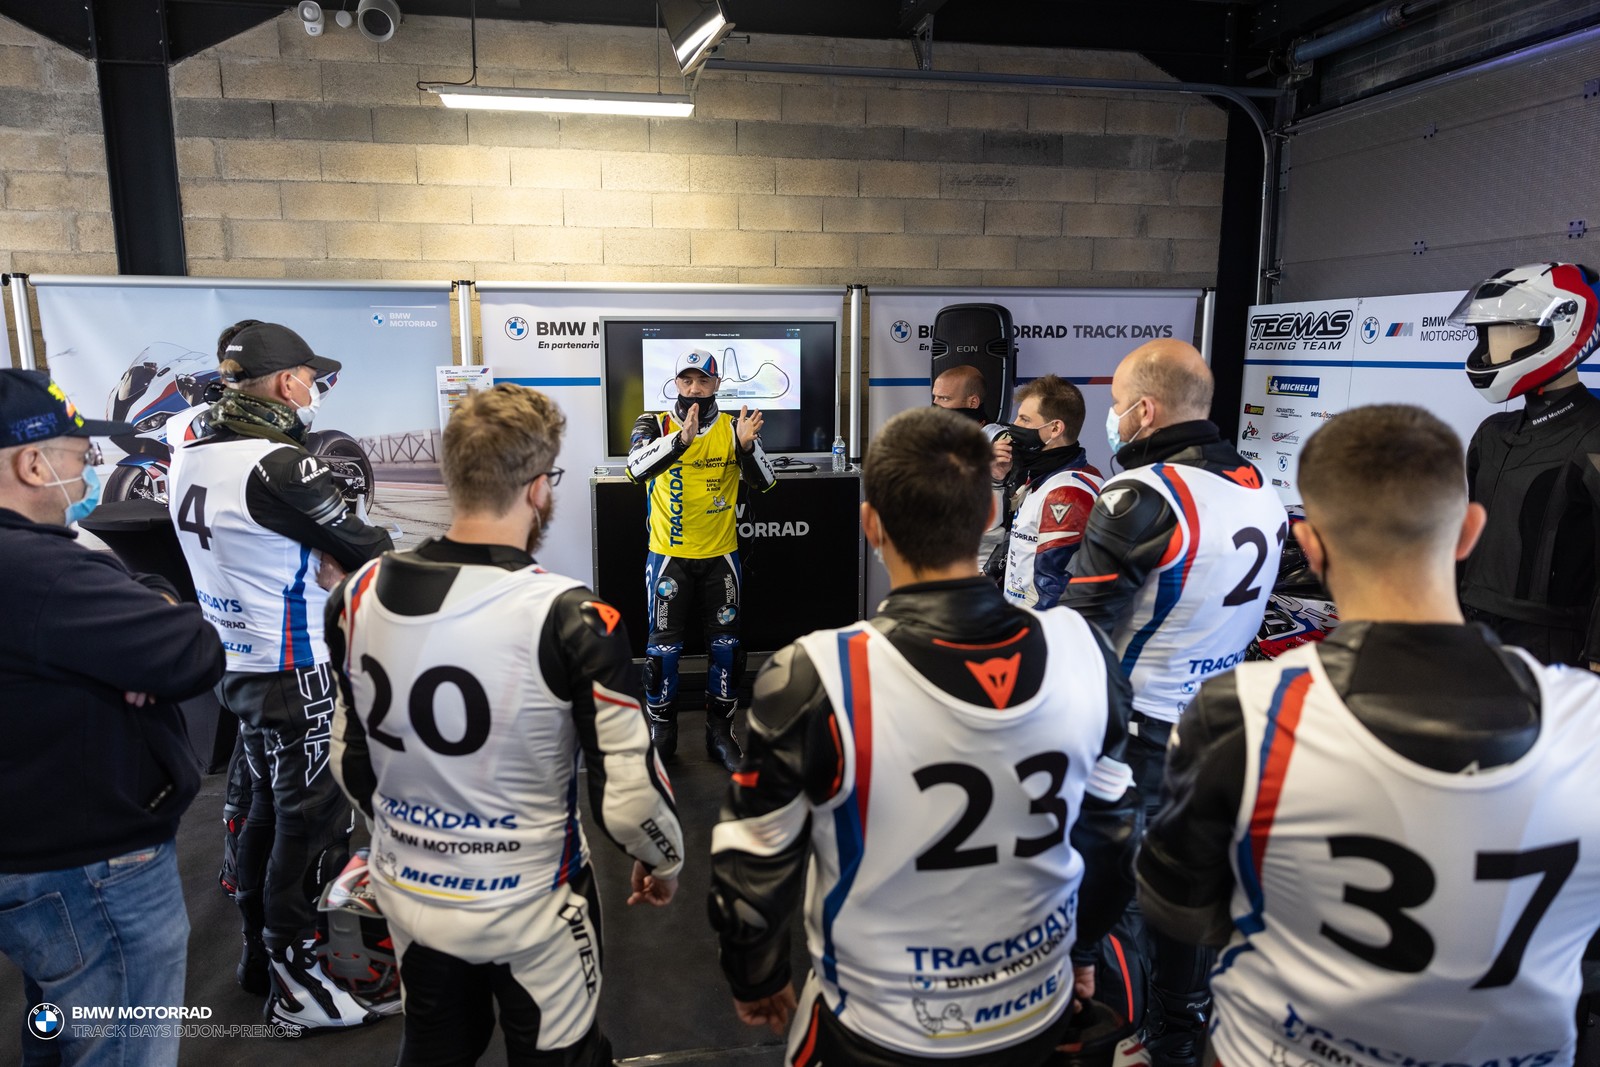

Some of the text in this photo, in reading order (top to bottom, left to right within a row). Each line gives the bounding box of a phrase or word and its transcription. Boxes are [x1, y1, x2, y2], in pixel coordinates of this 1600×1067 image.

[389, 320, 438, 328] MOTORRAD
[536, 321, 586, 336] BMW
[1250, 310, 1353, 341] TECMAS
[1422, 316, 1446, 327] BMW
[1073, 325, 1128, 338] TRACK
[1131, 325, 1173, 338] DAYS
[538, 340, 600, 351] En partenaria
[919, 343, 929, 351] En
[956, 345, 978, 353] EON
[1249, 341, 1342, 350] RACING TEAM
[1279, 383, 1318, 392] MICHELIN
[1532, 402, 1574, 426] BMW Motorrad
[1240, 450, 1259, 459] FRANCE
[177, 483, 213, 551] 4
[736, 521, 810, 538] ORRAD
[361, 653, 491, 757] 20
[378, 795, 518, 830] TRACKDAYS
[912, 750, 1069, 872] 23
[390, 828, 521, 854] BMW MOTORRAD
[400, 866, 521, 891] MICHELIN
[1318, 832, 1580, 990] 37
[945, 971, 997, 989] BMW
